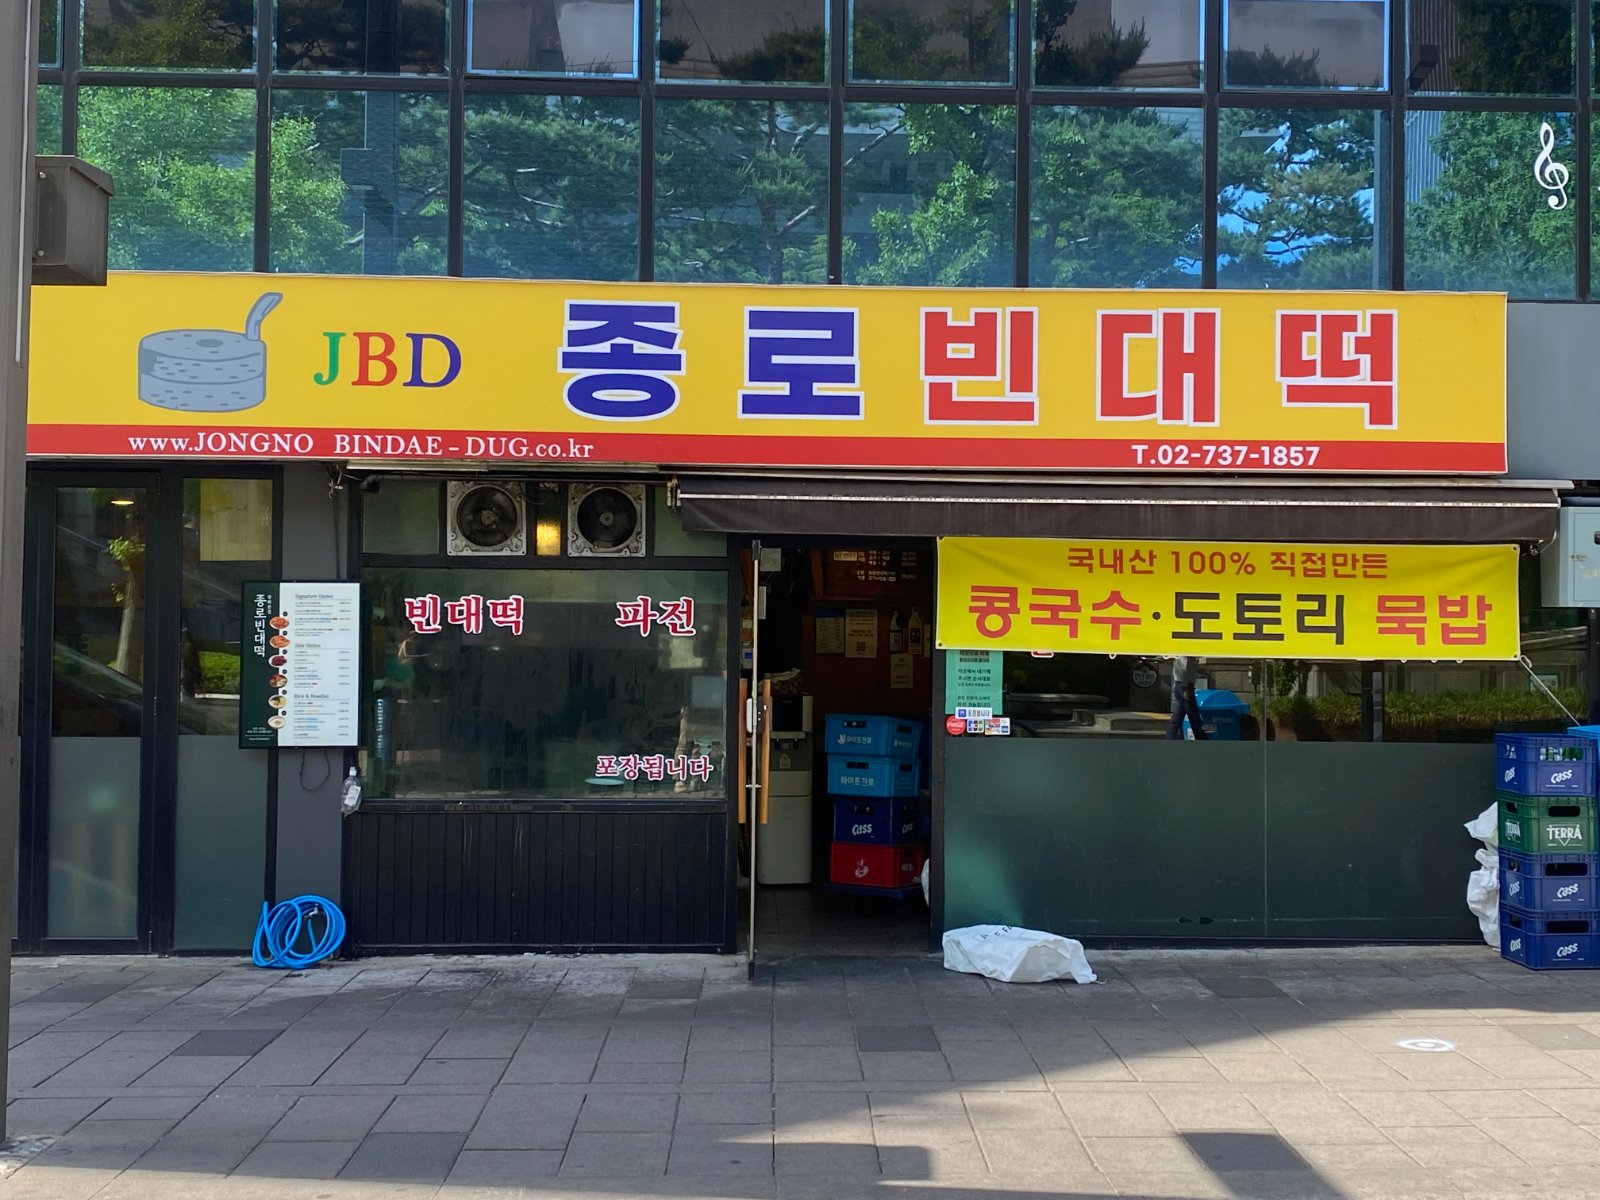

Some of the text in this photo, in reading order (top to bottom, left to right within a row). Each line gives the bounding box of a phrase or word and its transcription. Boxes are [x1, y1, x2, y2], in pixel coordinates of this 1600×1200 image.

[313, 331, 463, 388] JBD
[128, 432, 314, 453] www.JONGNO
[1131, 443, 1321, 467] T.02-737-1857
[1067, 547, 1389, 580] 국내산 100% 직접만든
[254, 594, 267, 658] 종로빈대떡
[404, 594, 525, 636] 빈대떡
[615, 596, 697, 638] 파전
[1375, 593, 1493, 646] 묵밥
[594, 754, 714, 783] 포장됩니다
[1550, 769, 1573, 784] Cass
[851, 823, 873, 836] Cass
[1546, 824, 1583, 840] TERRA
[1556, 883, 1579, 898] Cass
[1556, 942, 1578, 957] Cass
